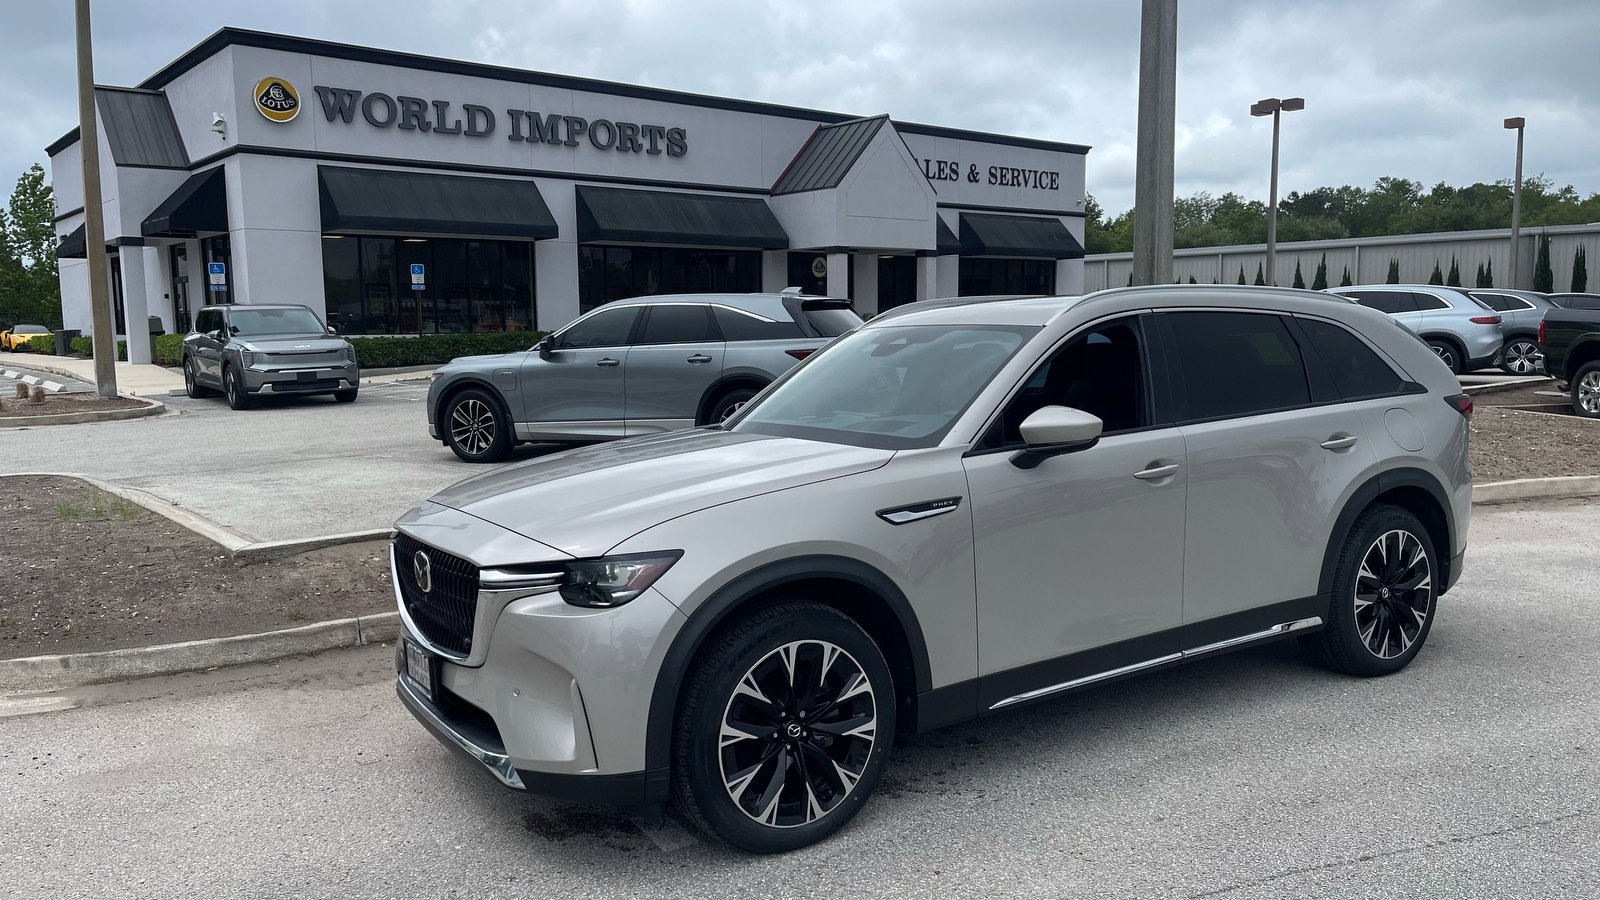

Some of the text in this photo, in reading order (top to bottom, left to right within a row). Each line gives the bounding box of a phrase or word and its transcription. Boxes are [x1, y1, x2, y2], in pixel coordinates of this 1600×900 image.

[261, 97, 295, 108] LOTUS
[314, 85, 688, 157] WORLD IMPORTS
[915, 157, 1060, 190] LES & SERVICE
